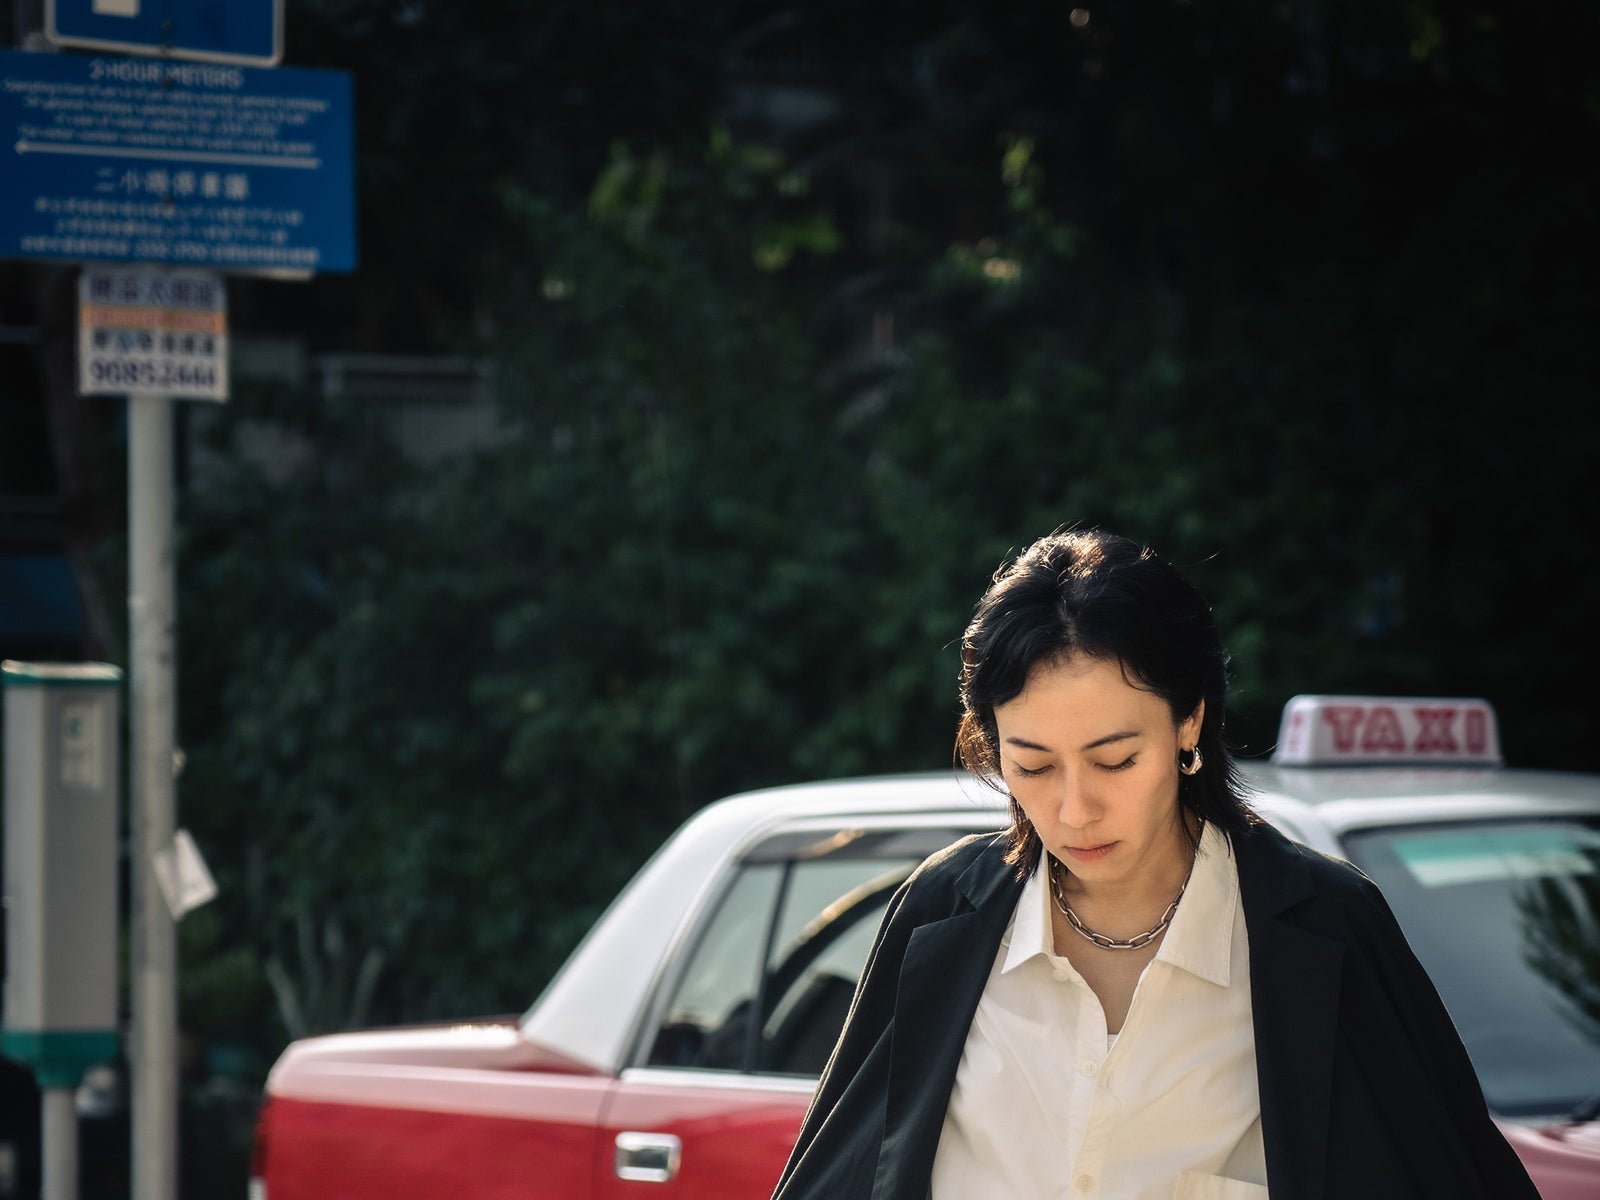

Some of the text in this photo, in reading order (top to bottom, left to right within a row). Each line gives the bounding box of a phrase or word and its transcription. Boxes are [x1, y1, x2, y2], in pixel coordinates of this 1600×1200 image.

[89, 59, 244, 89] 2-HOUR METERS
[1322, 706, 1486, 753] TAXI
